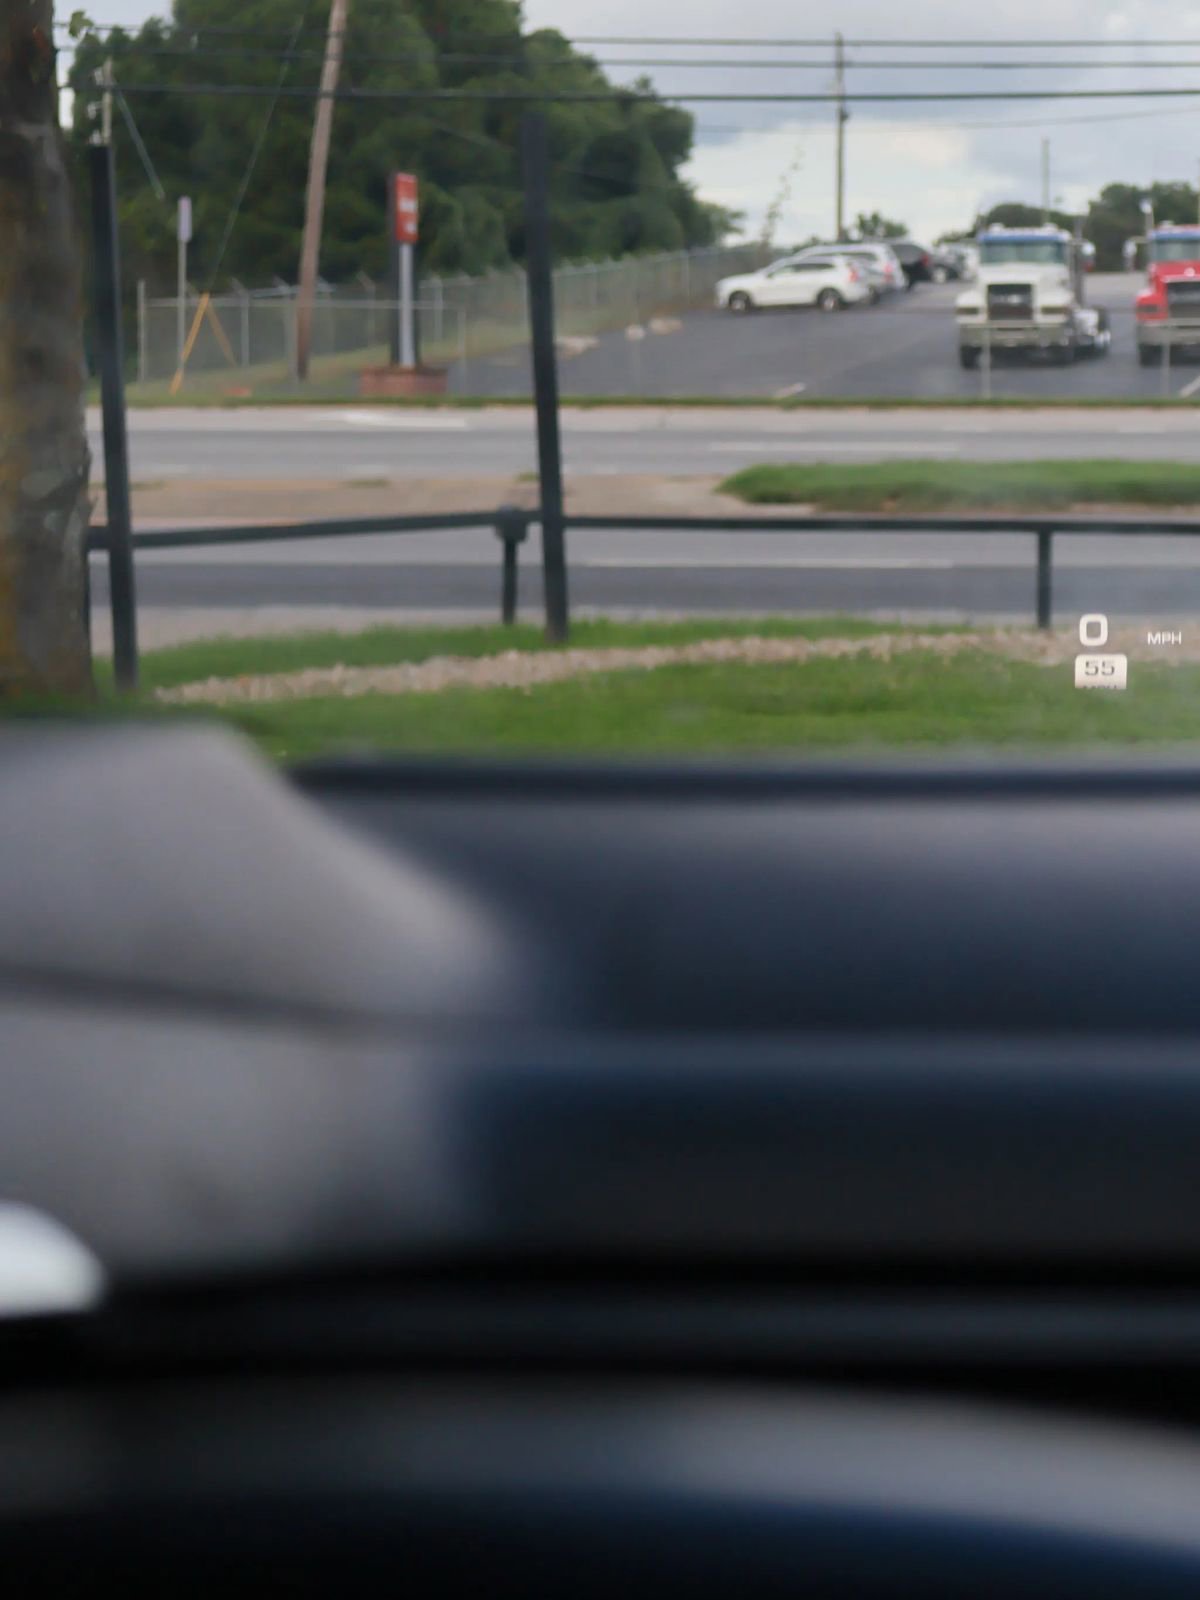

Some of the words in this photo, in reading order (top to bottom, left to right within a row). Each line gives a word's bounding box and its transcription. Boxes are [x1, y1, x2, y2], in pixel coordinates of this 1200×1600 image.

[1079, 613, 1108, 646] 0
[1147, 631, 1182, 645] MPH
[1084, 660, 1115, 676] 55
